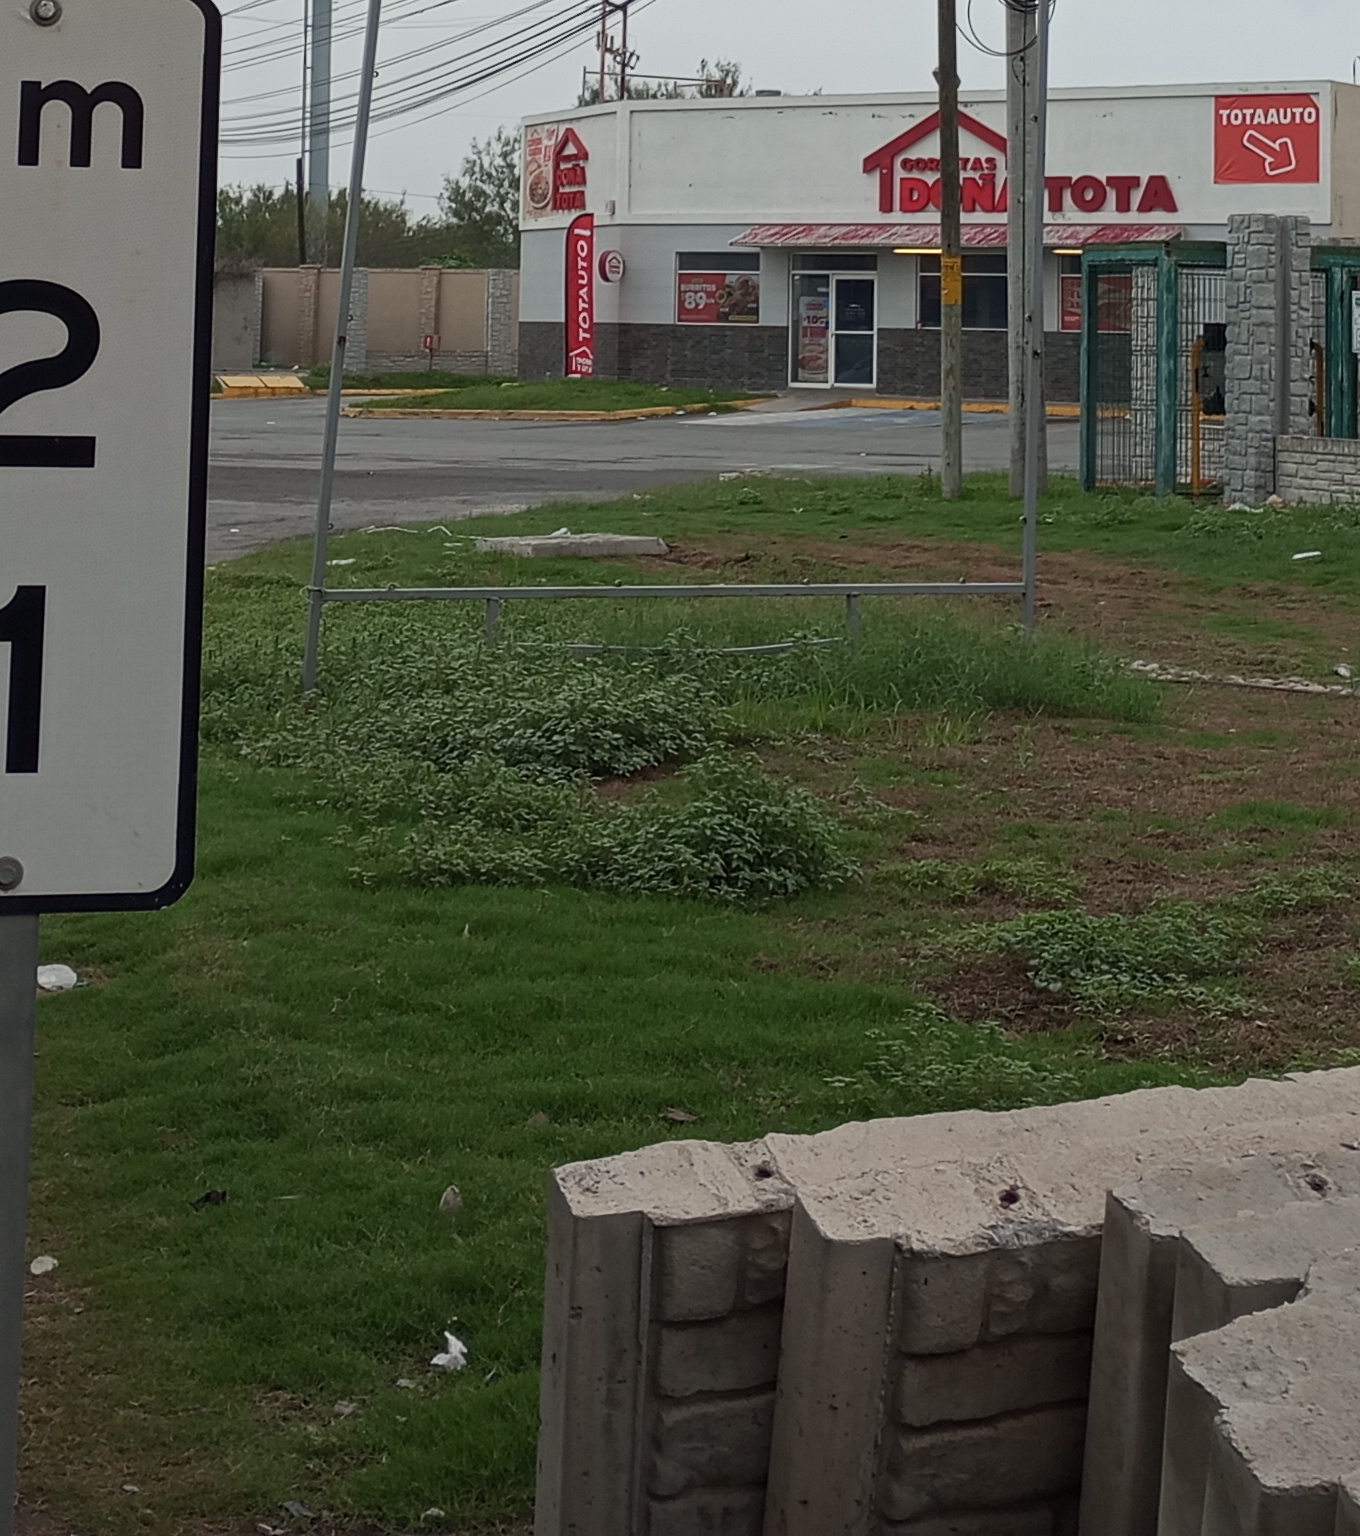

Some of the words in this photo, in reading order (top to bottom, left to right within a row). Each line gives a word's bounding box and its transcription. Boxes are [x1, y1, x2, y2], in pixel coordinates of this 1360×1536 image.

[1219, 107, 1316, 126] TOTAAUTO
[899, 157, 997, 172] GORTAS
[1043, 175, 1178, 212] TOTA
